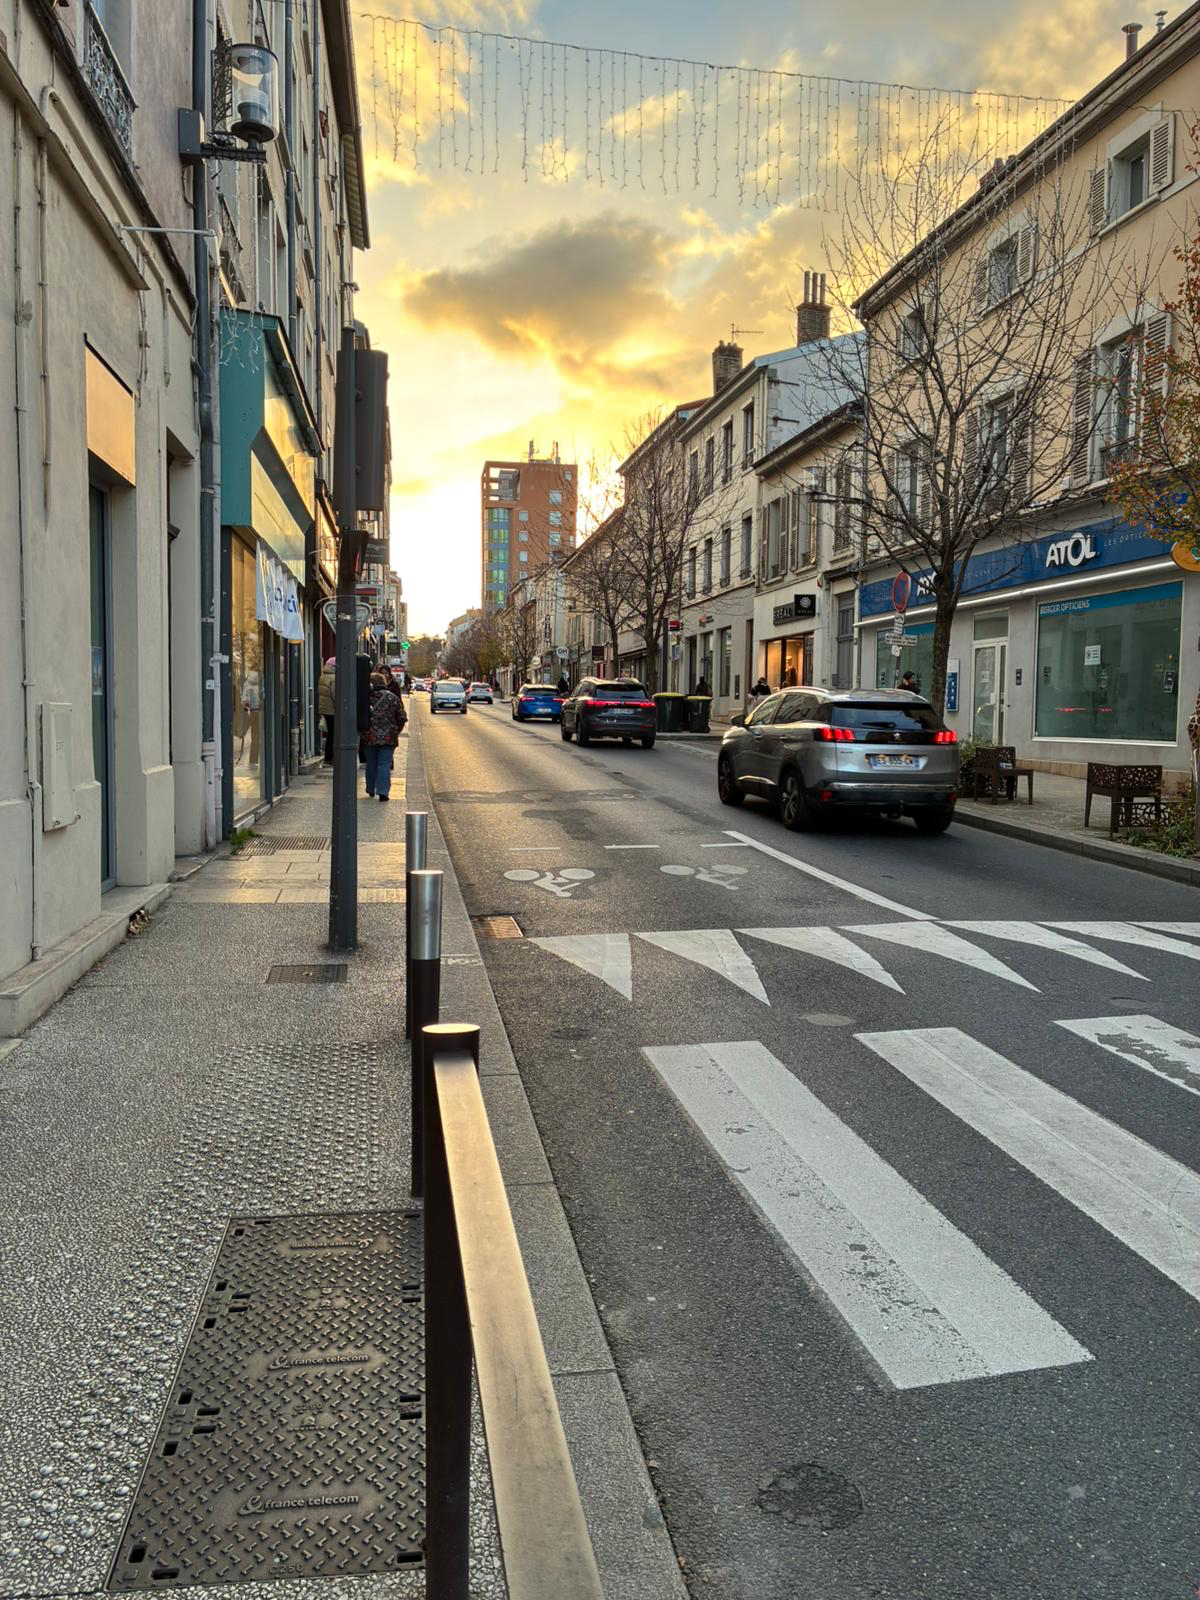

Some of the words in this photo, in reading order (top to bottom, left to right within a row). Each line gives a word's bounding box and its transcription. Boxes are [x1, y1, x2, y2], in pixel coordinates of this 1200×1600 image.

[1060, 599, 1090, 611] OPTICIENS
[289, 1358, 323, 1367] france
[325, 1354, 369, 1364] telecom
[265, 1497, 305, 1510] france
[308, 1494, 360, 1507] telecom
[269, 1562, 304, 1575] C250
